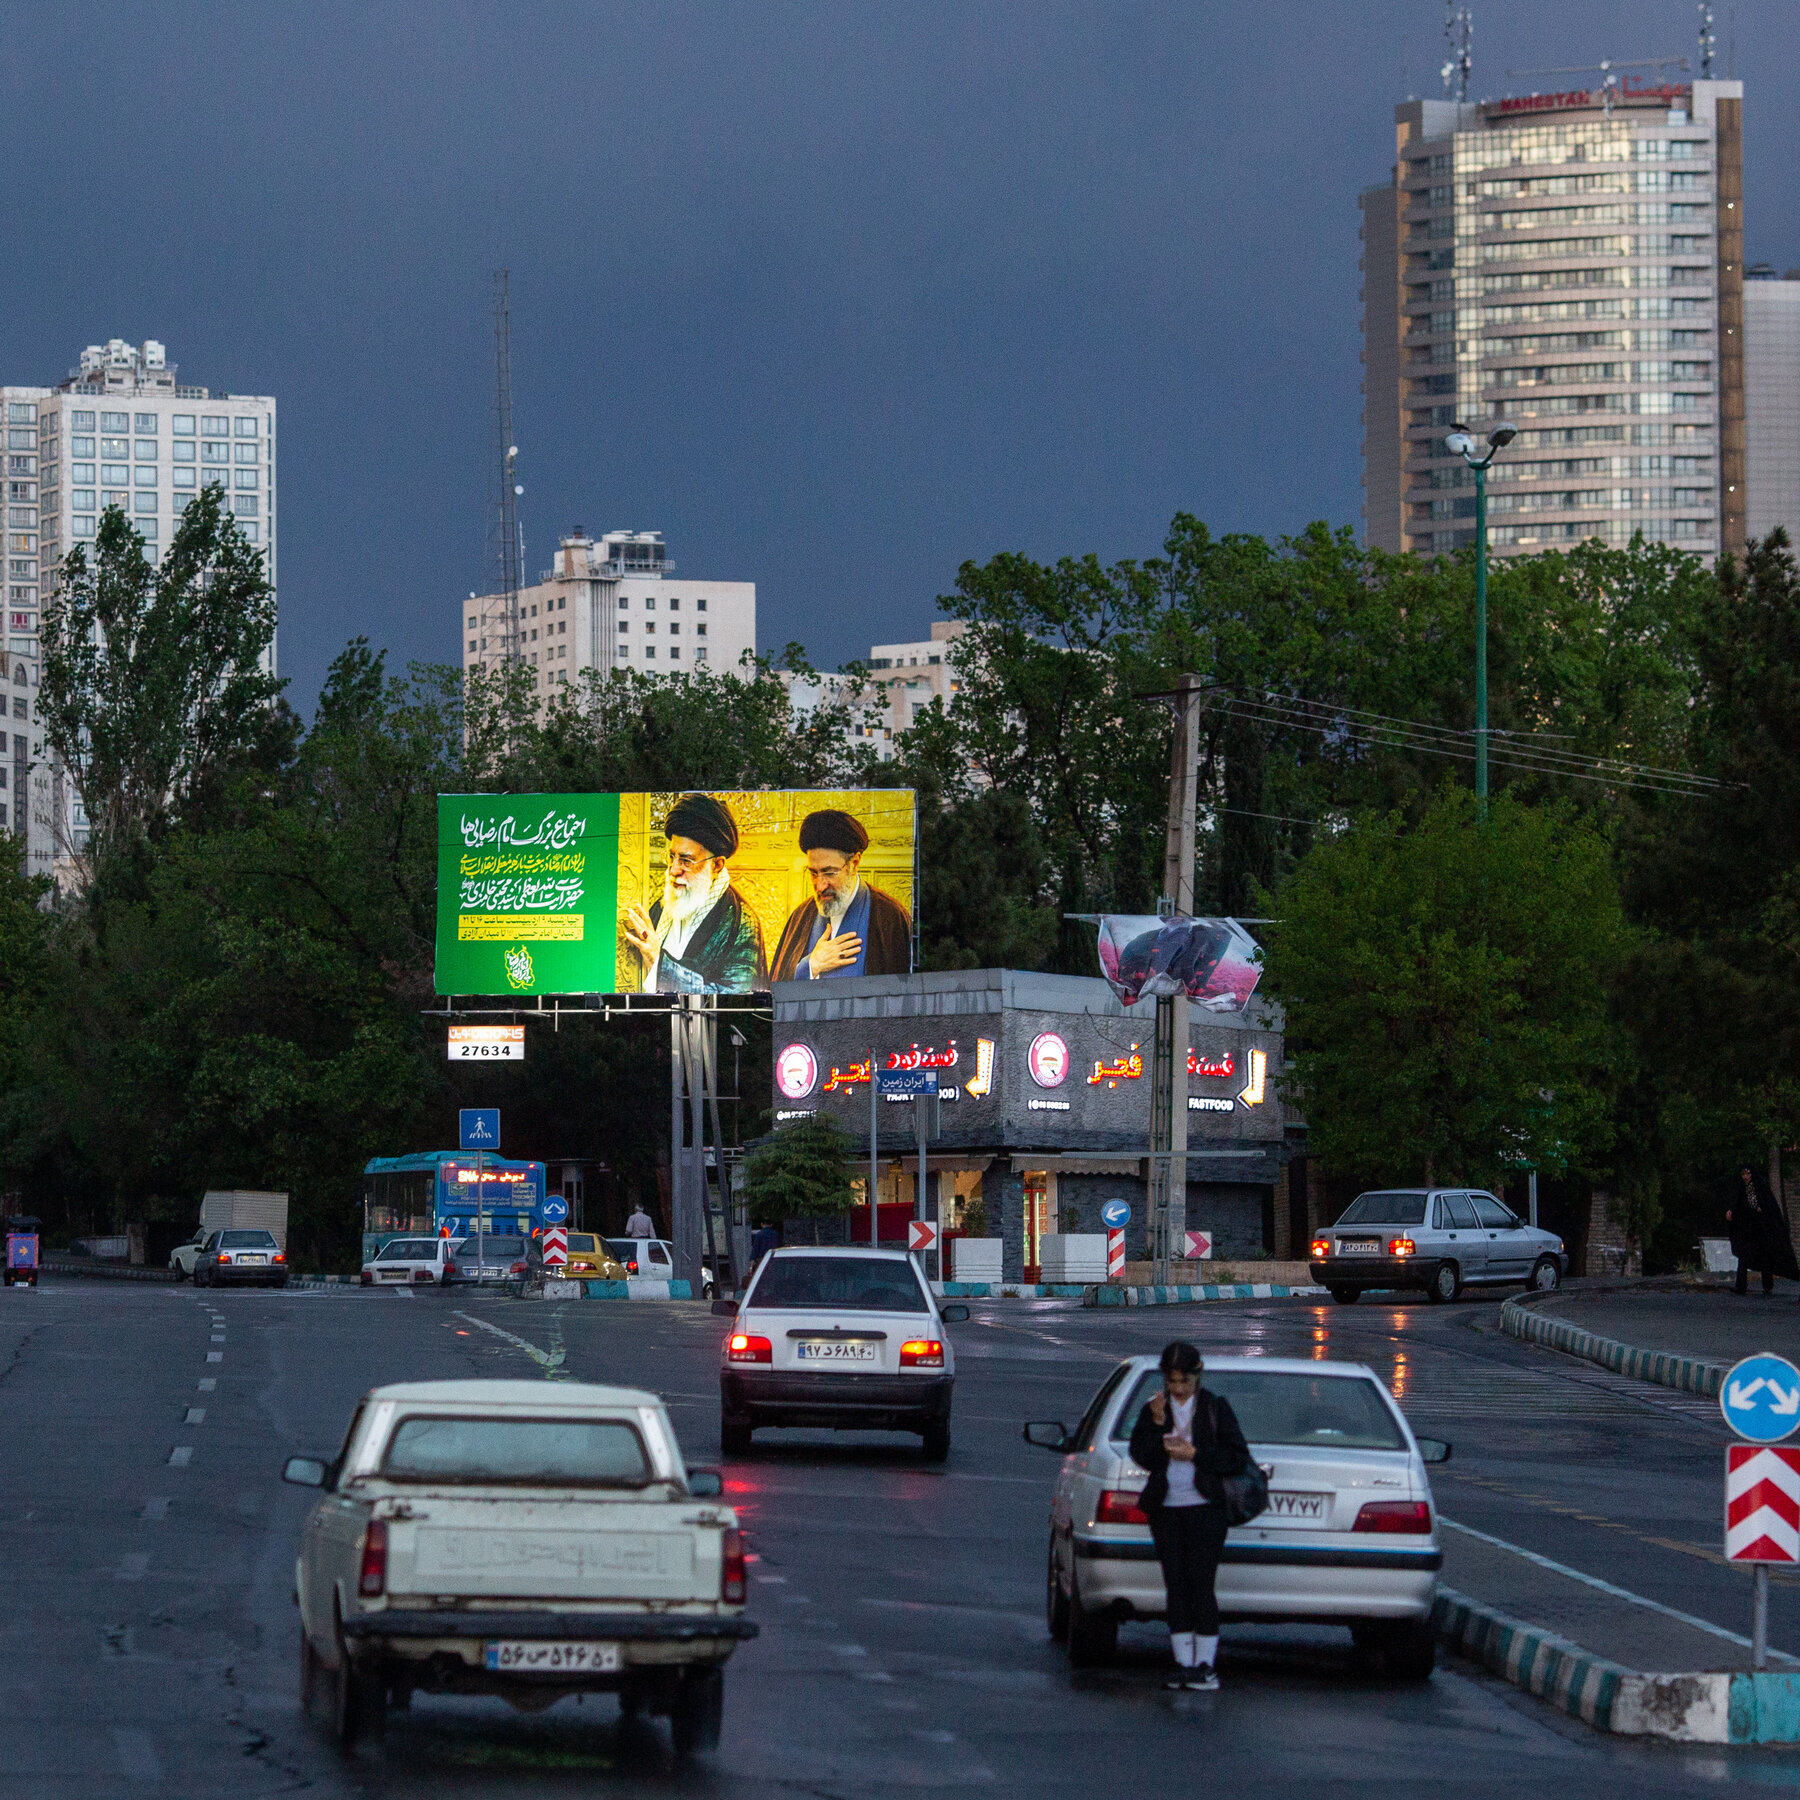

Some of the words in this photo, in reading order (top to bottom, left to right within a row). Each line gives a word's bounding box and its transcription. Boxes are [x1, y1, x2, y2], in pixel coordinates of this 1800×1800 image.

[1500, 90, 1590, 111] MAHESTAN
[498, 816, 516, 852] امام
[510, 810, 556, 850] بزرگ
[551, 814, 586, 849] اجتماع
[461, 1045, 511, 1056] 27634
[1086, 1042, 1142, 1088] فجر
[882, 1076, 903, 1088] زمین
[904, 1076, 925, 1088] ایران
[1188, 1098, 1234, 1111] FASTFOOD
